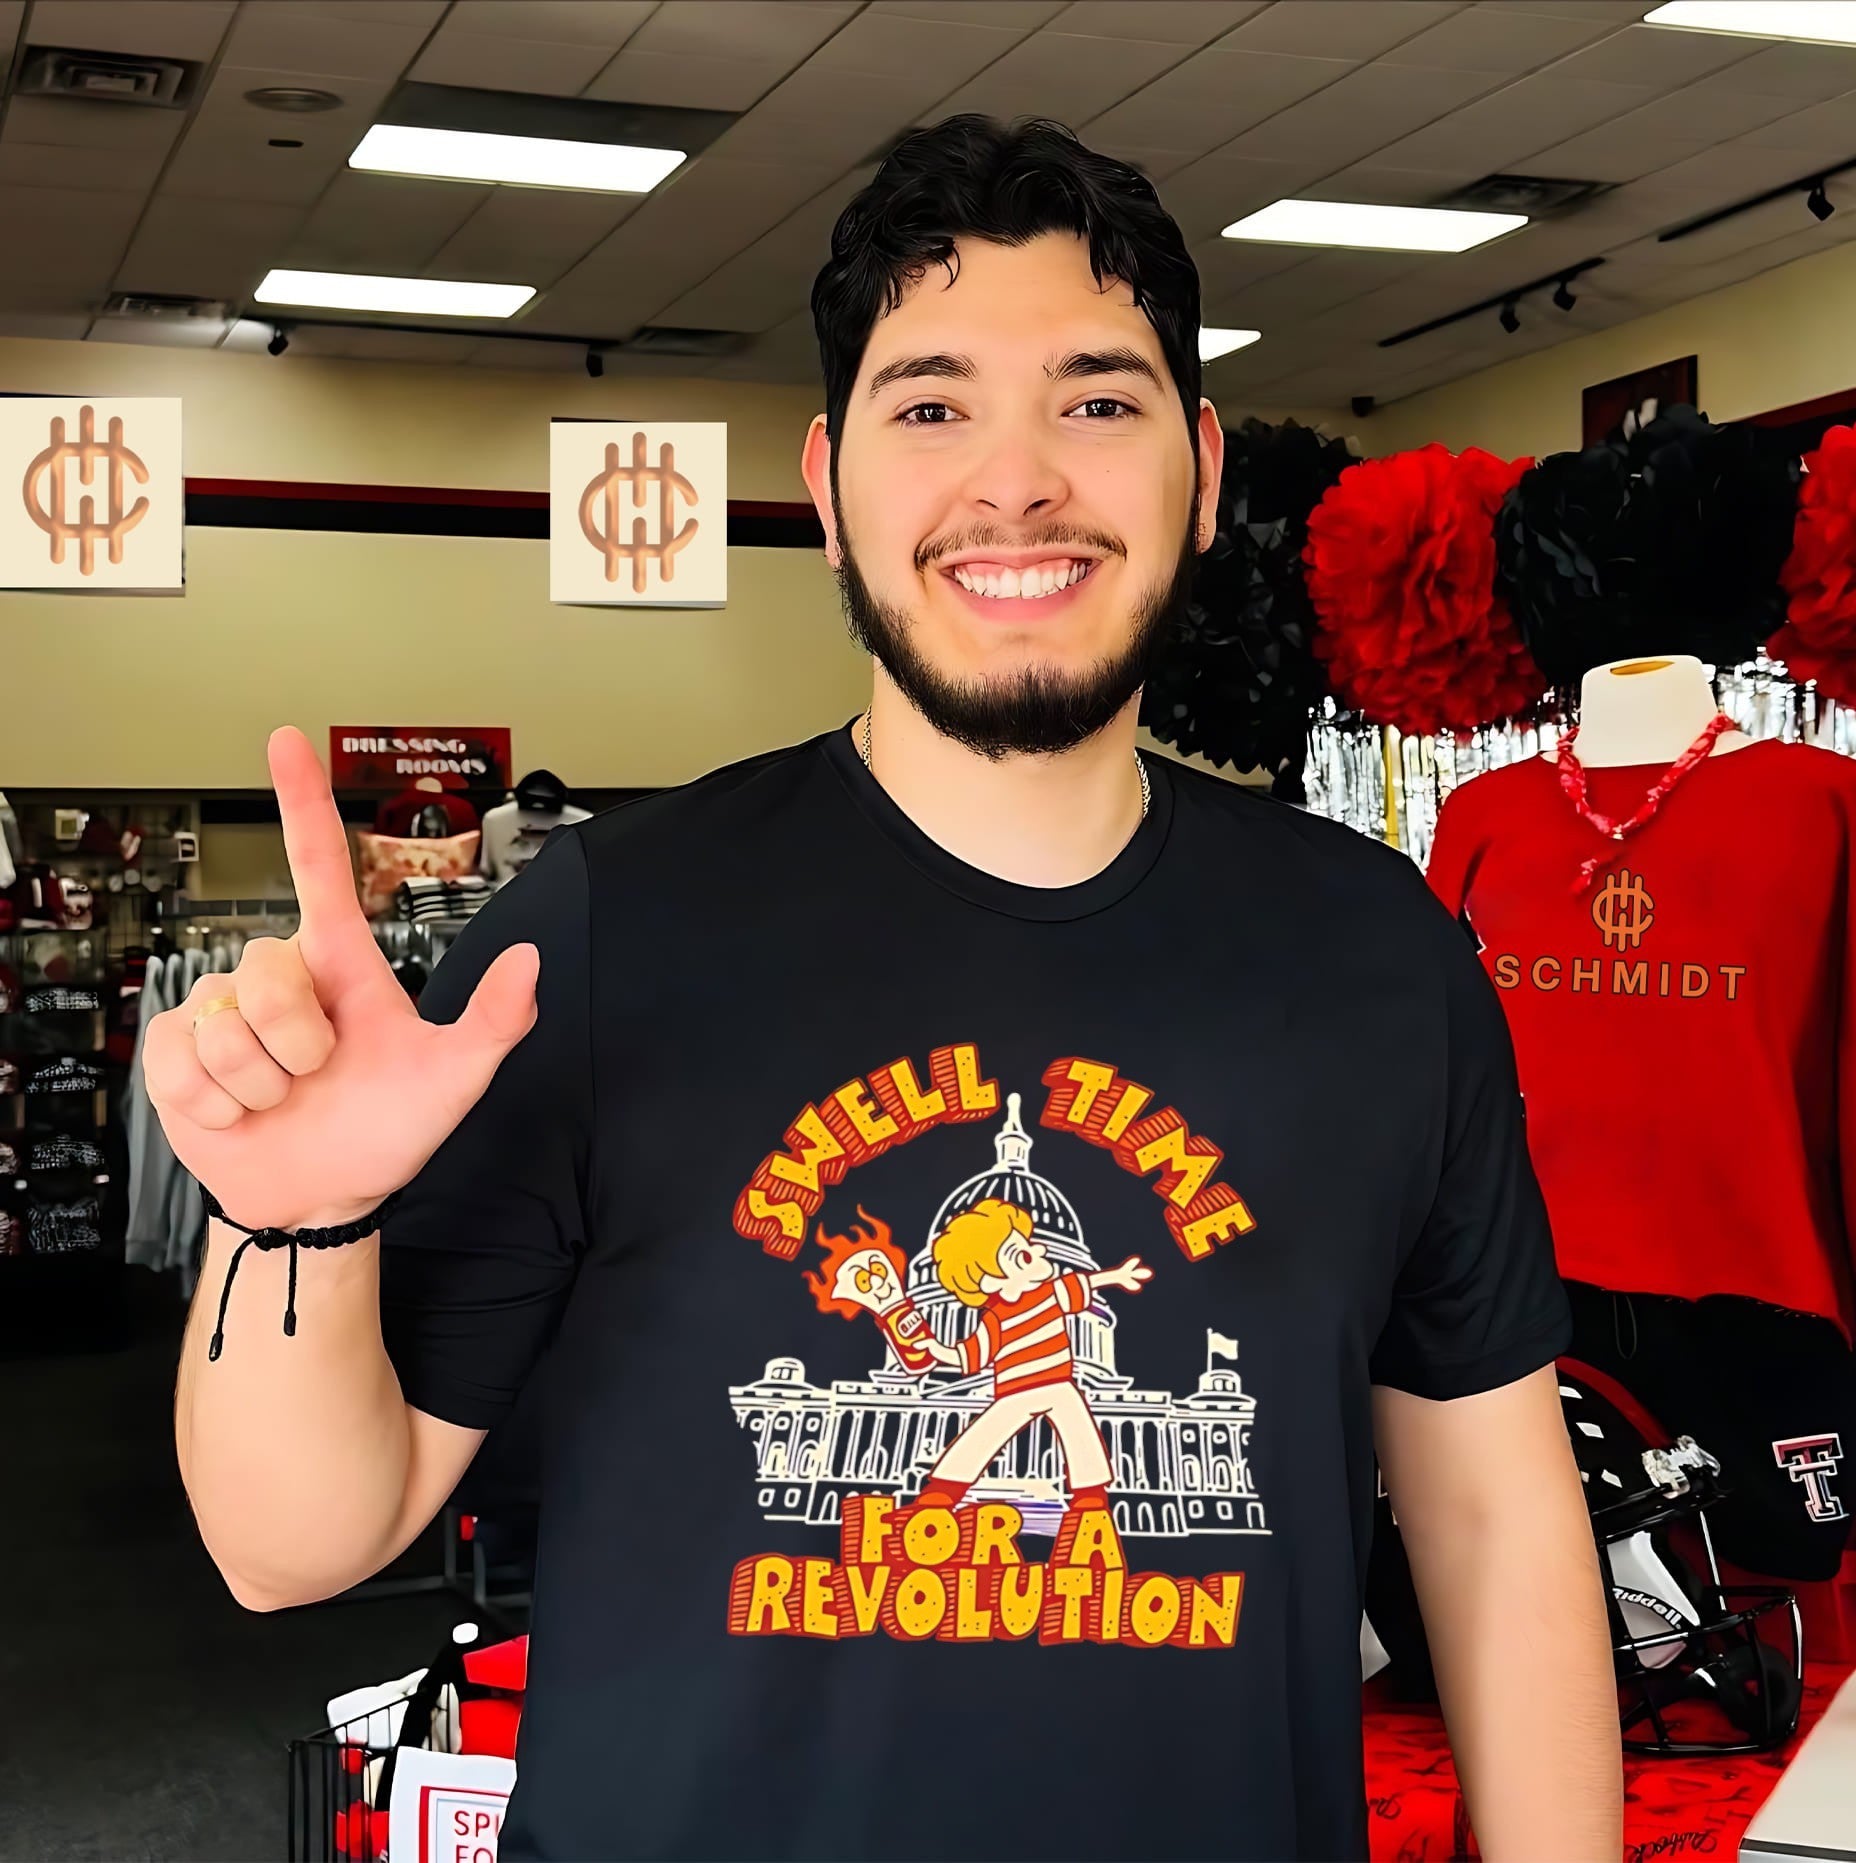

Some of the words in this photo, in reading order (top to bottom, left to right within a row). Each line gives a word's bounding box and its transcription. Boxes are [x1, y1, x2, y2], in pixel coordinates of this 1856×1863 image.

[396, 759, 487, 775] ROOMS
[1493, 953, 1747, 1001] SCHMIDT
[733, 1042, 998, 1262] SWELL
[1040, 1056, 1257, 1262] TIME
[841, 1495, 1024, 1566] FOR
[1052, 1497, 1126, 1569] A
[727, 1553, 1245, 1648] REVOLUTION
